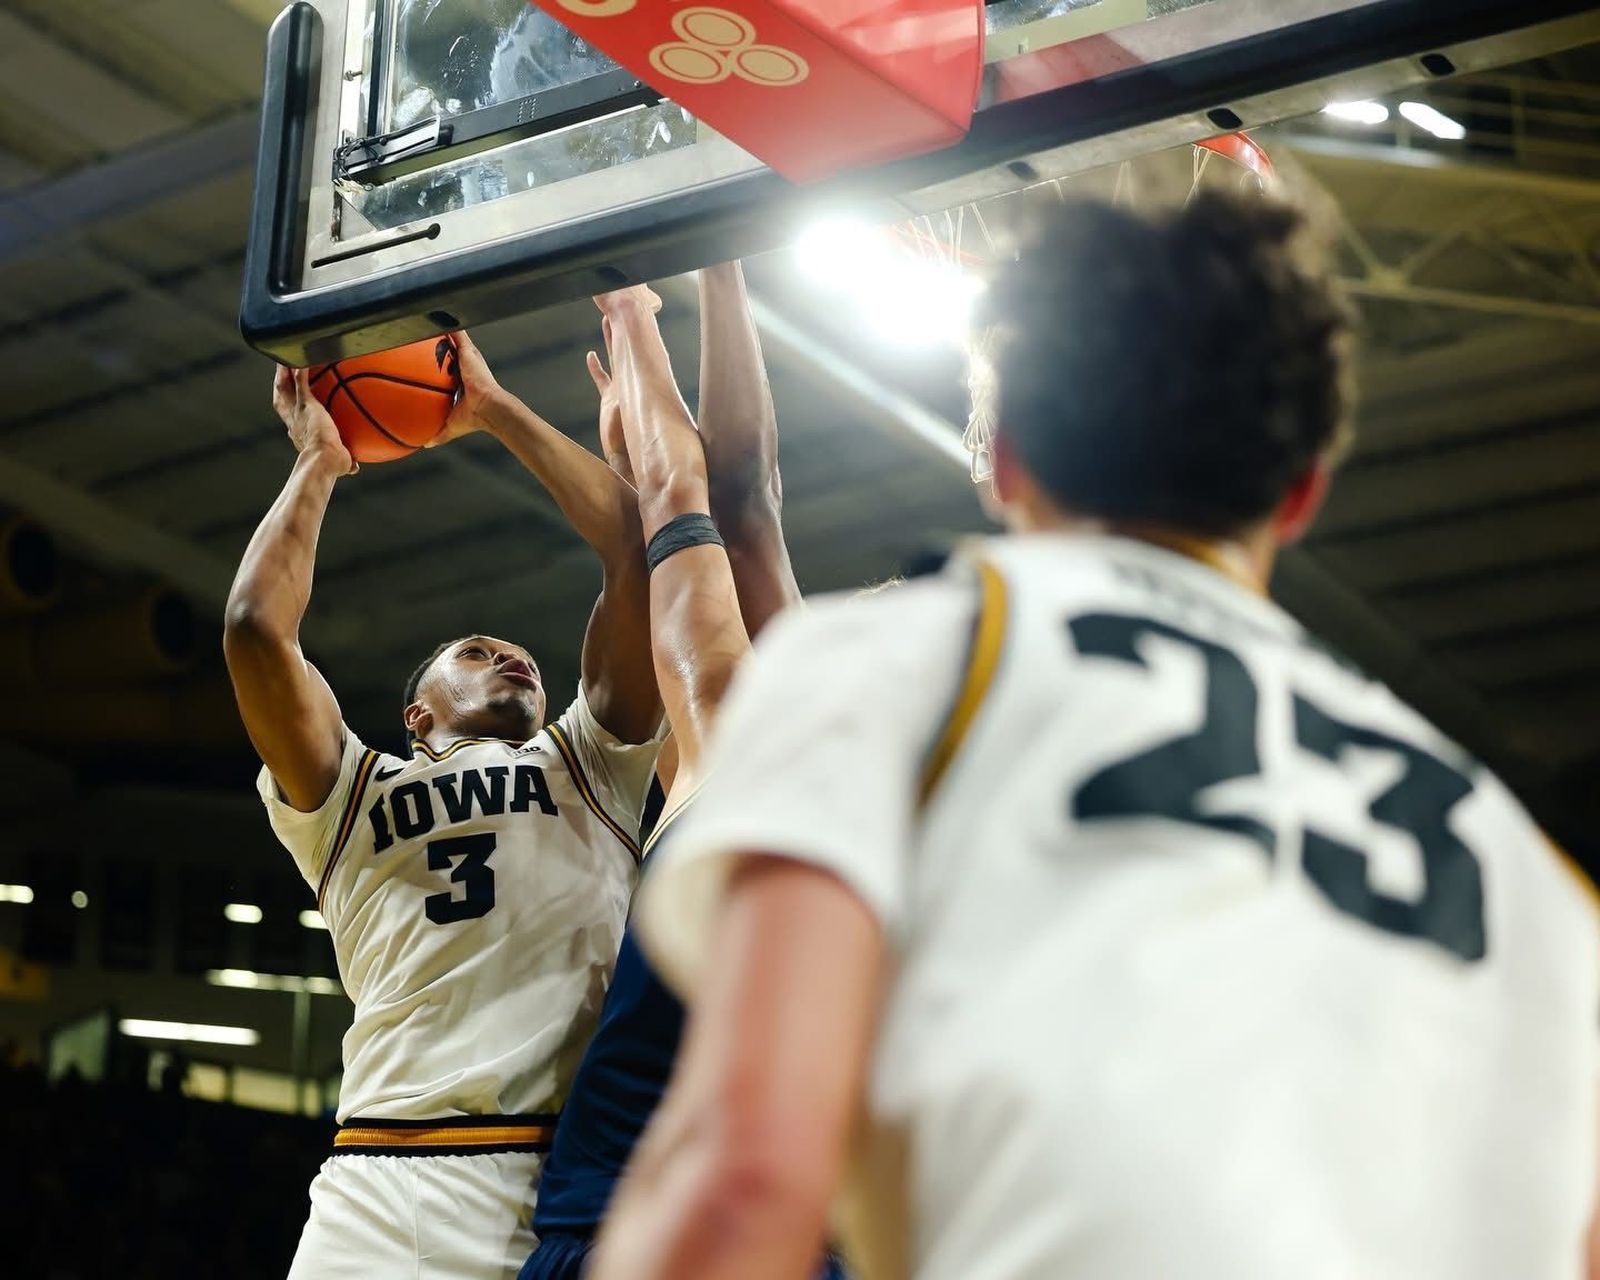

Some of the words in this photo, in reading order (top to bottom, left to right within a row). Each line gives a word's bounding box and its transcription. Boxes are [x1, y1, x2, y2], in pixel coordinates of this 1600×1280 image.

[368, 765, 559, 854] IOWA
[1068, 612, 1487, 962] 23
[425, 832, 497, 925] 3
